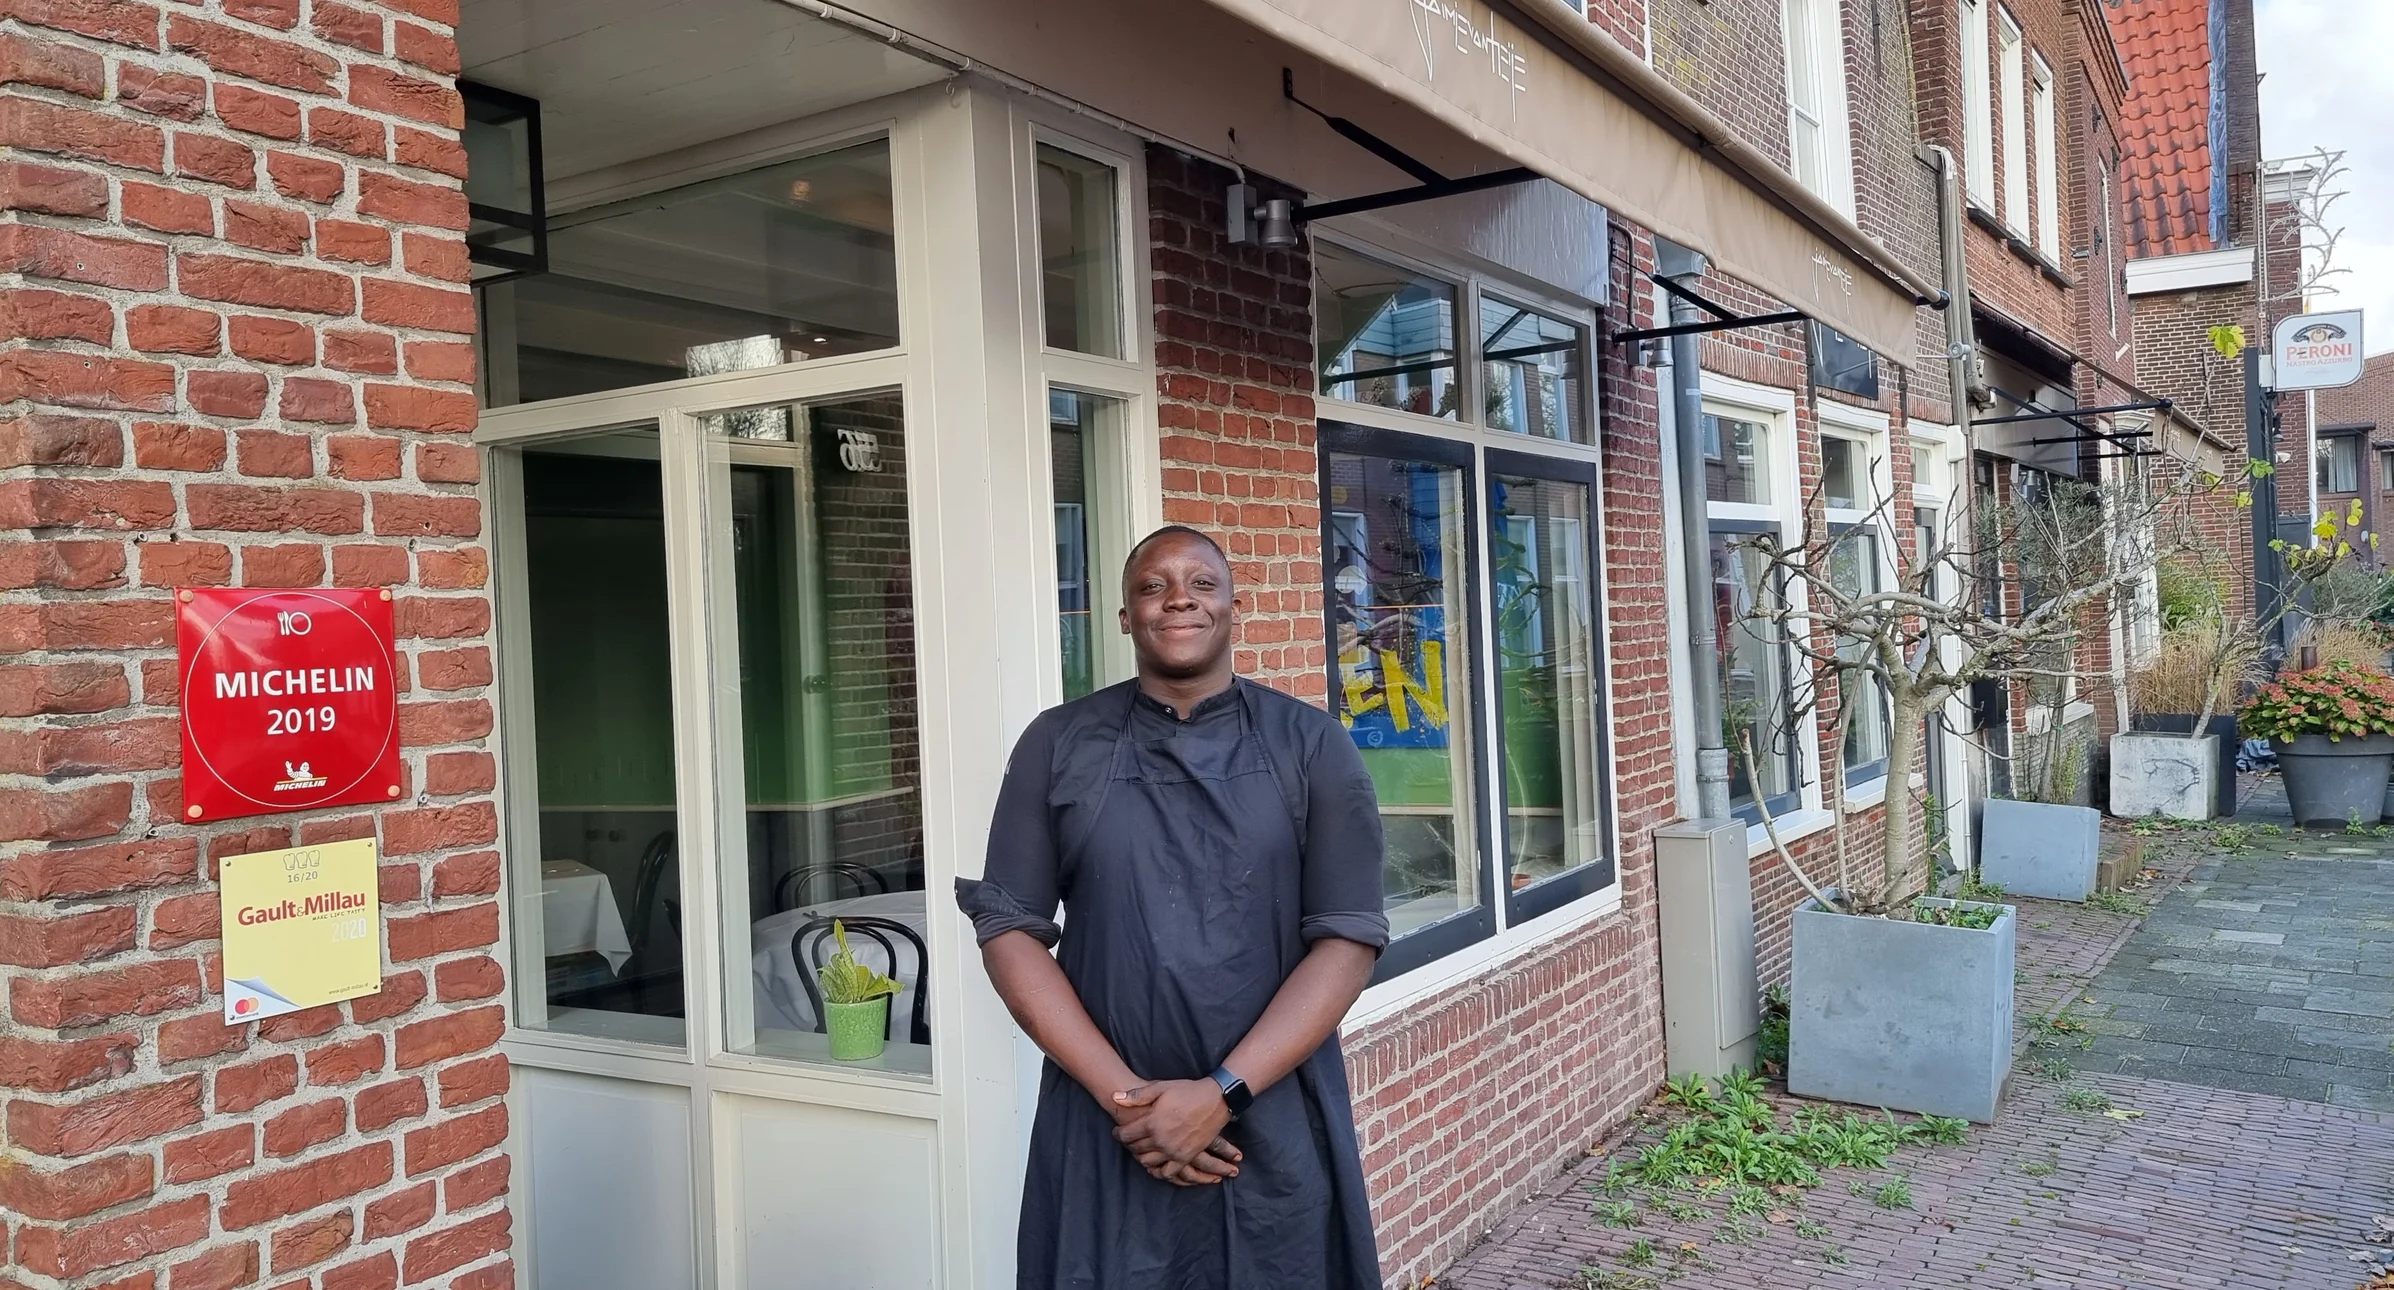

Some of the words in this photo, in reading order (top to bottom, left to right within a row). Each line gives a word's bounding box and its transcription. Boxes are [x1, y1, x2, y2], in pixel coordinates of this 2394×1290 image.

[2286, 343, 2352, 360] PERONI
[2286, 359, 2317, 367] NASTRO
[2317, 357, 2353, 365] AZZURRO
[215, 667, 374, 699] MICHELIN
[267, 706, 336, 735] 2019
[273, 780, 327, 792] MICHELIN
[288, 871, 318, 883] 16/20
[332, 918, 367, 942] 2020
